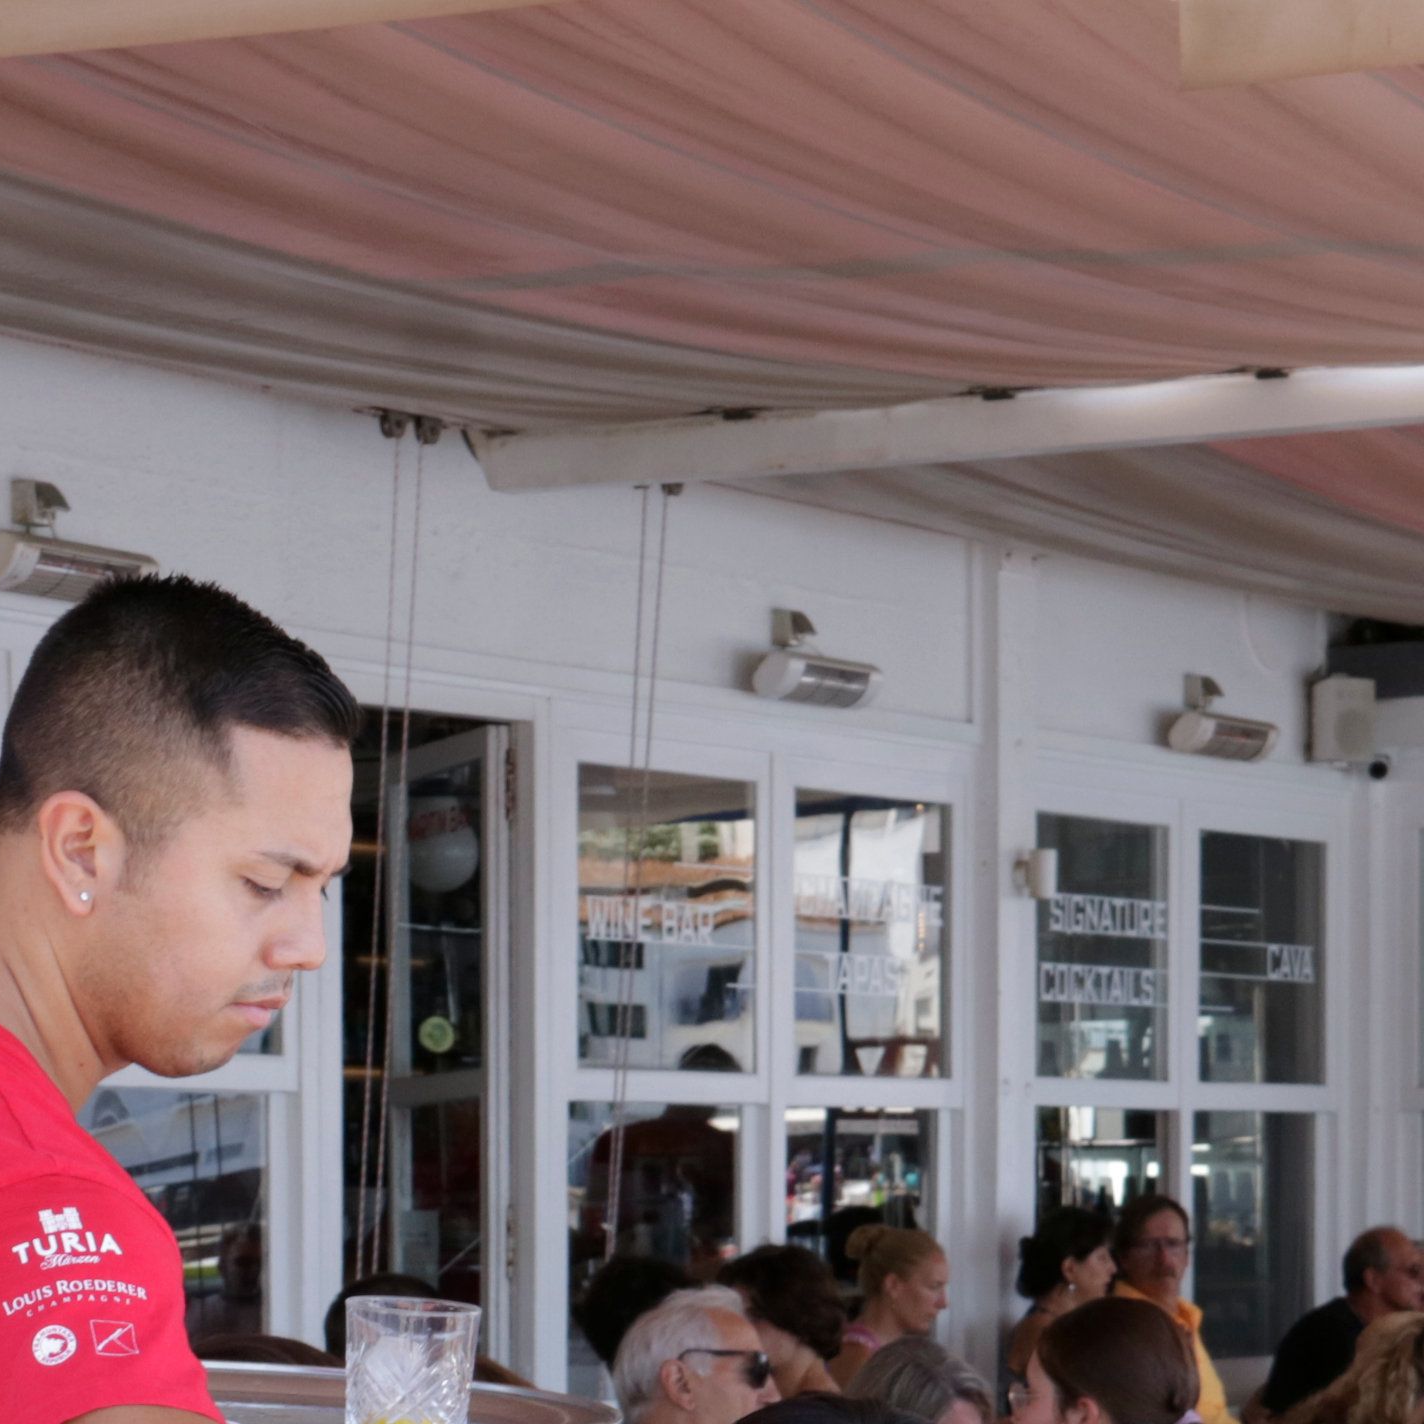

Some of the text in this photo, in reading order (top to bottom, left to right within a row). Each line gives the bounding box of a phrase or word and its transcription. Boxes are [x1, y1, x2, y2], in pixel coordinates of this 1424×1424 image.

[586, 894, 715, 945] WINE BAR
[1049, 895, 1168, 939] SIGNATURE
[1039, 962, 1155, 1005] COCKTAILS
[1266, 945, 1315, 983] CAVA
[11, 1230, 123, 1265] TURIA
[1, 1278, 148, 1317] LOUIS ROEDERER
